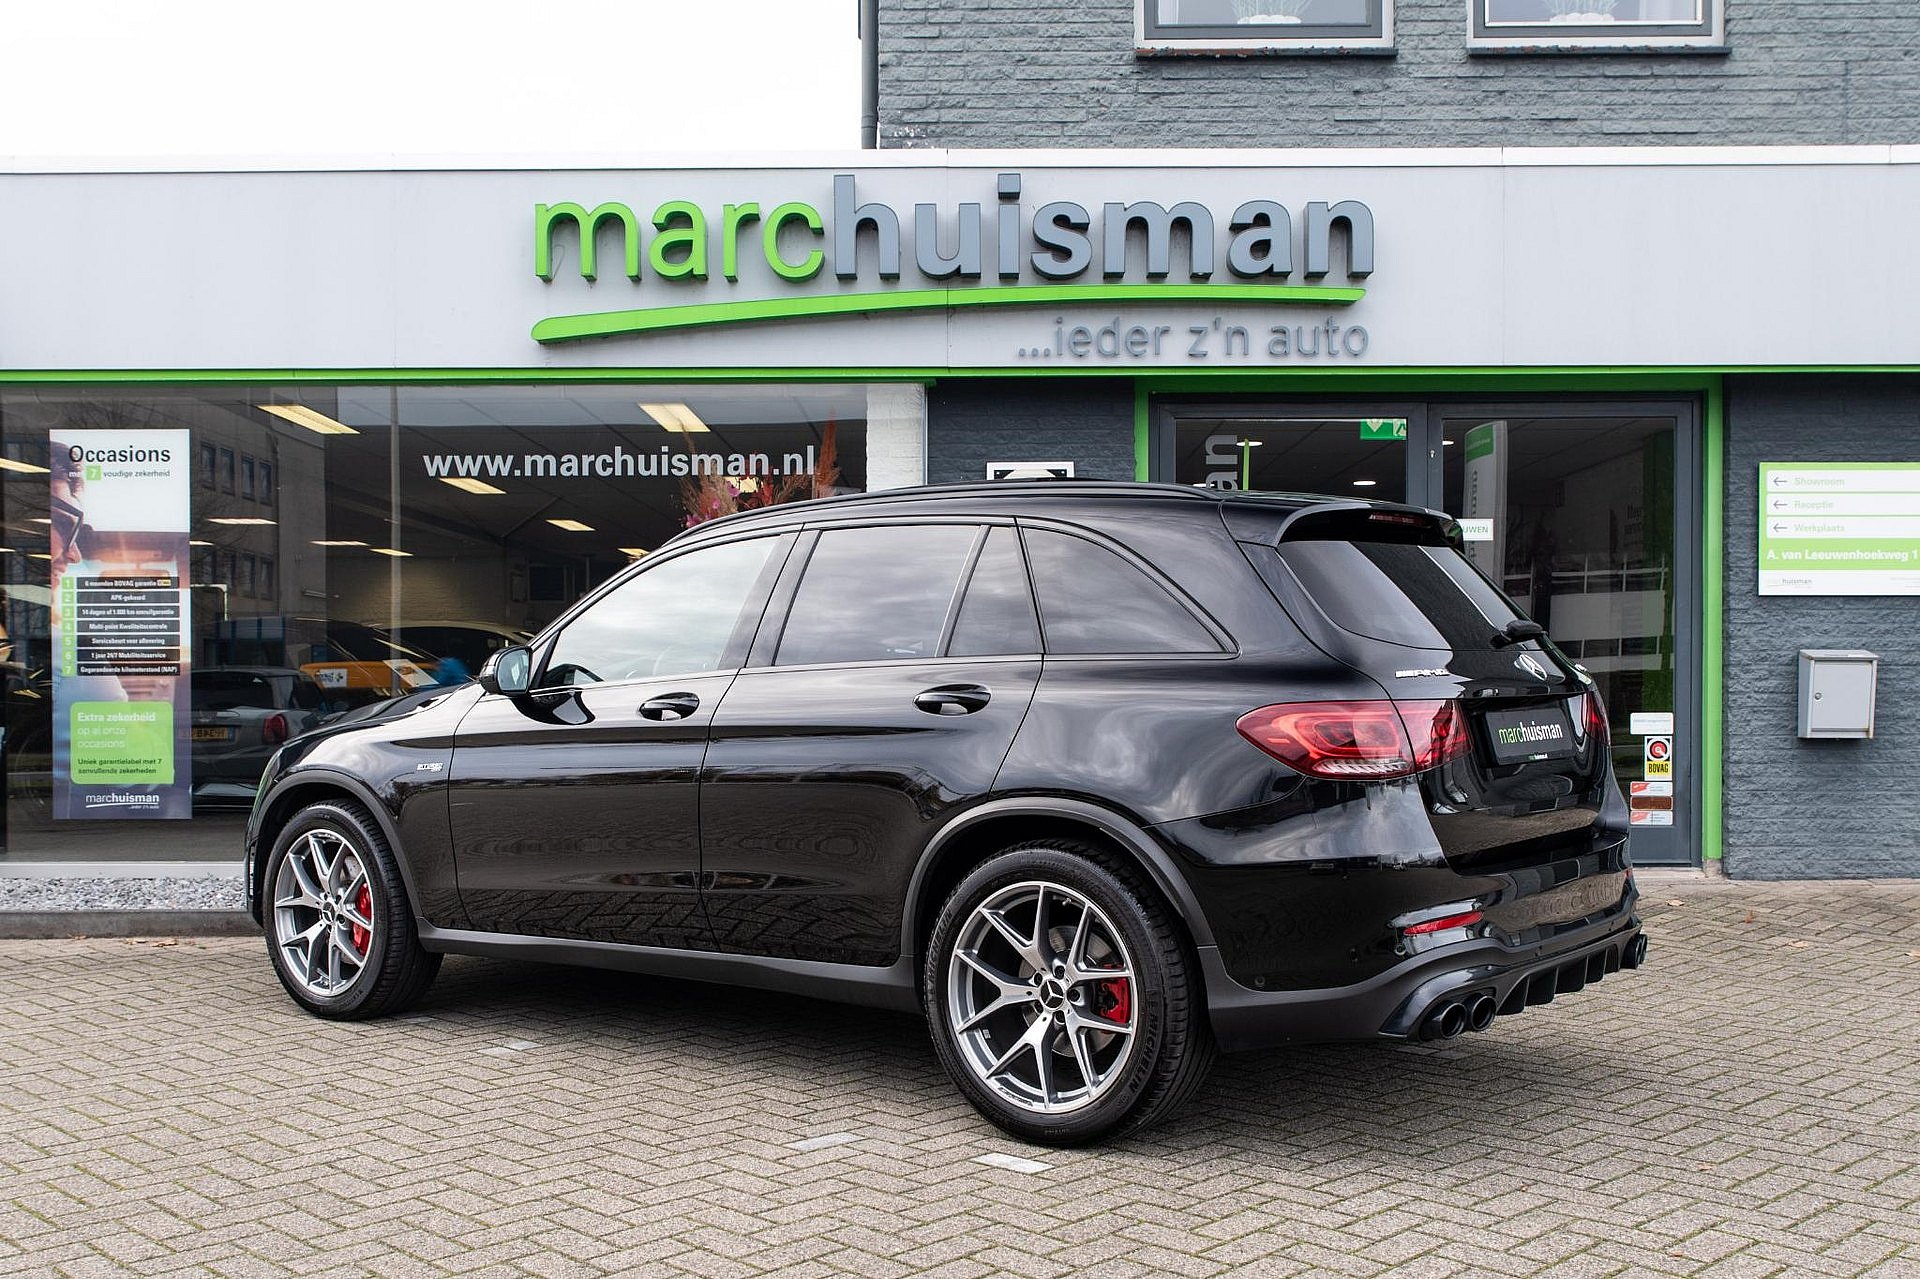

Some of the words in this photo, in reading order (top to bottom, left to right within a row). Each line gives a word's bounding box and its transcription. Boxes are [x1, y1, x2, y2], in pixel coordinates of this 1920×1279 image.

[534, 172, 1376, 282] marchuisman
[1187, 316, 1250, 357] z'n
[1267, 316, 1371, 357] auto
[69, 445, 171, 463] Occasions
[422, 445, 815, 477] www.marchuisman.nl
[103, 469, 133, 479] voudige
[134, 468, 171, 478] zekerheid
[1793, 477, 1846, 486] Showroom
[1462, 525, 1489, 534] UWEN
[1766, 550, 1779, 560] A.
[1782, 551, 1802, 560] van
[1805, 549, 1908, 562] Leeuwenhoekweg
[77, 712, 105, 721] Extra
[106, 712, 156, 721] zekerheid
[1499, 720, 1563, 745] marchuisman
[1648, 763, 1669, 774] BOVAG
[85, 792, 160, 803] marchuisman
